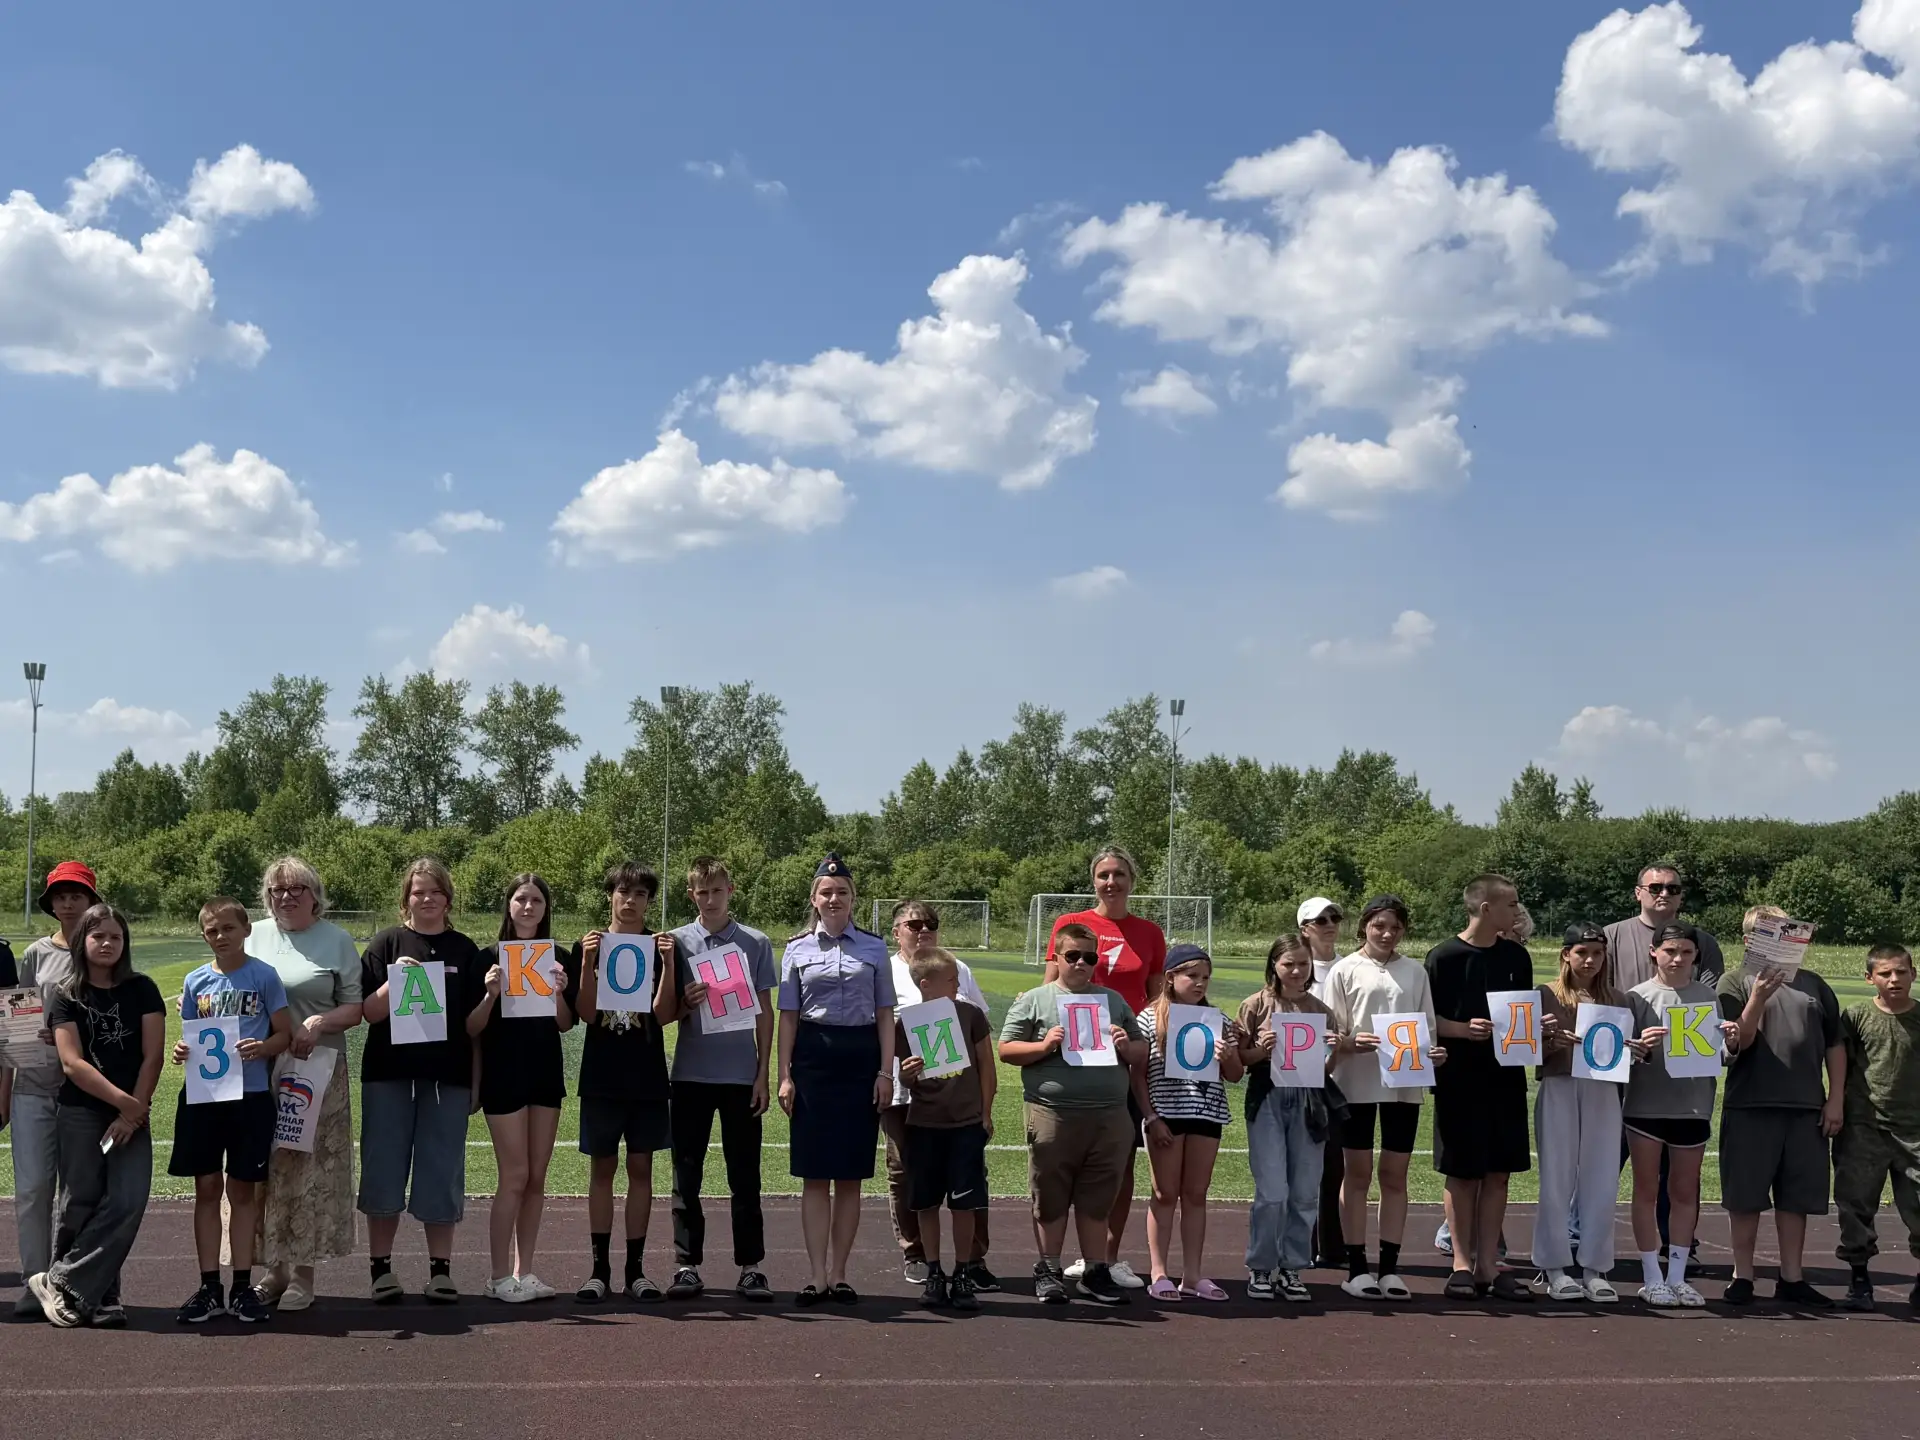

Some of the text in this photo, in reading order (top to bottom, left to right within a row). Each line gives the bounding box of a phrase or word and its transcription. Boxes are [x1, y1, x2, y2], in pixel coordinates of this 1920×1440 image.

[278, 1114, 305, 1126] ИНАЯ
[276, 1123, 303, 1135] ССИЯ
[273, 1131, 301, 1143] ЗБАСС
